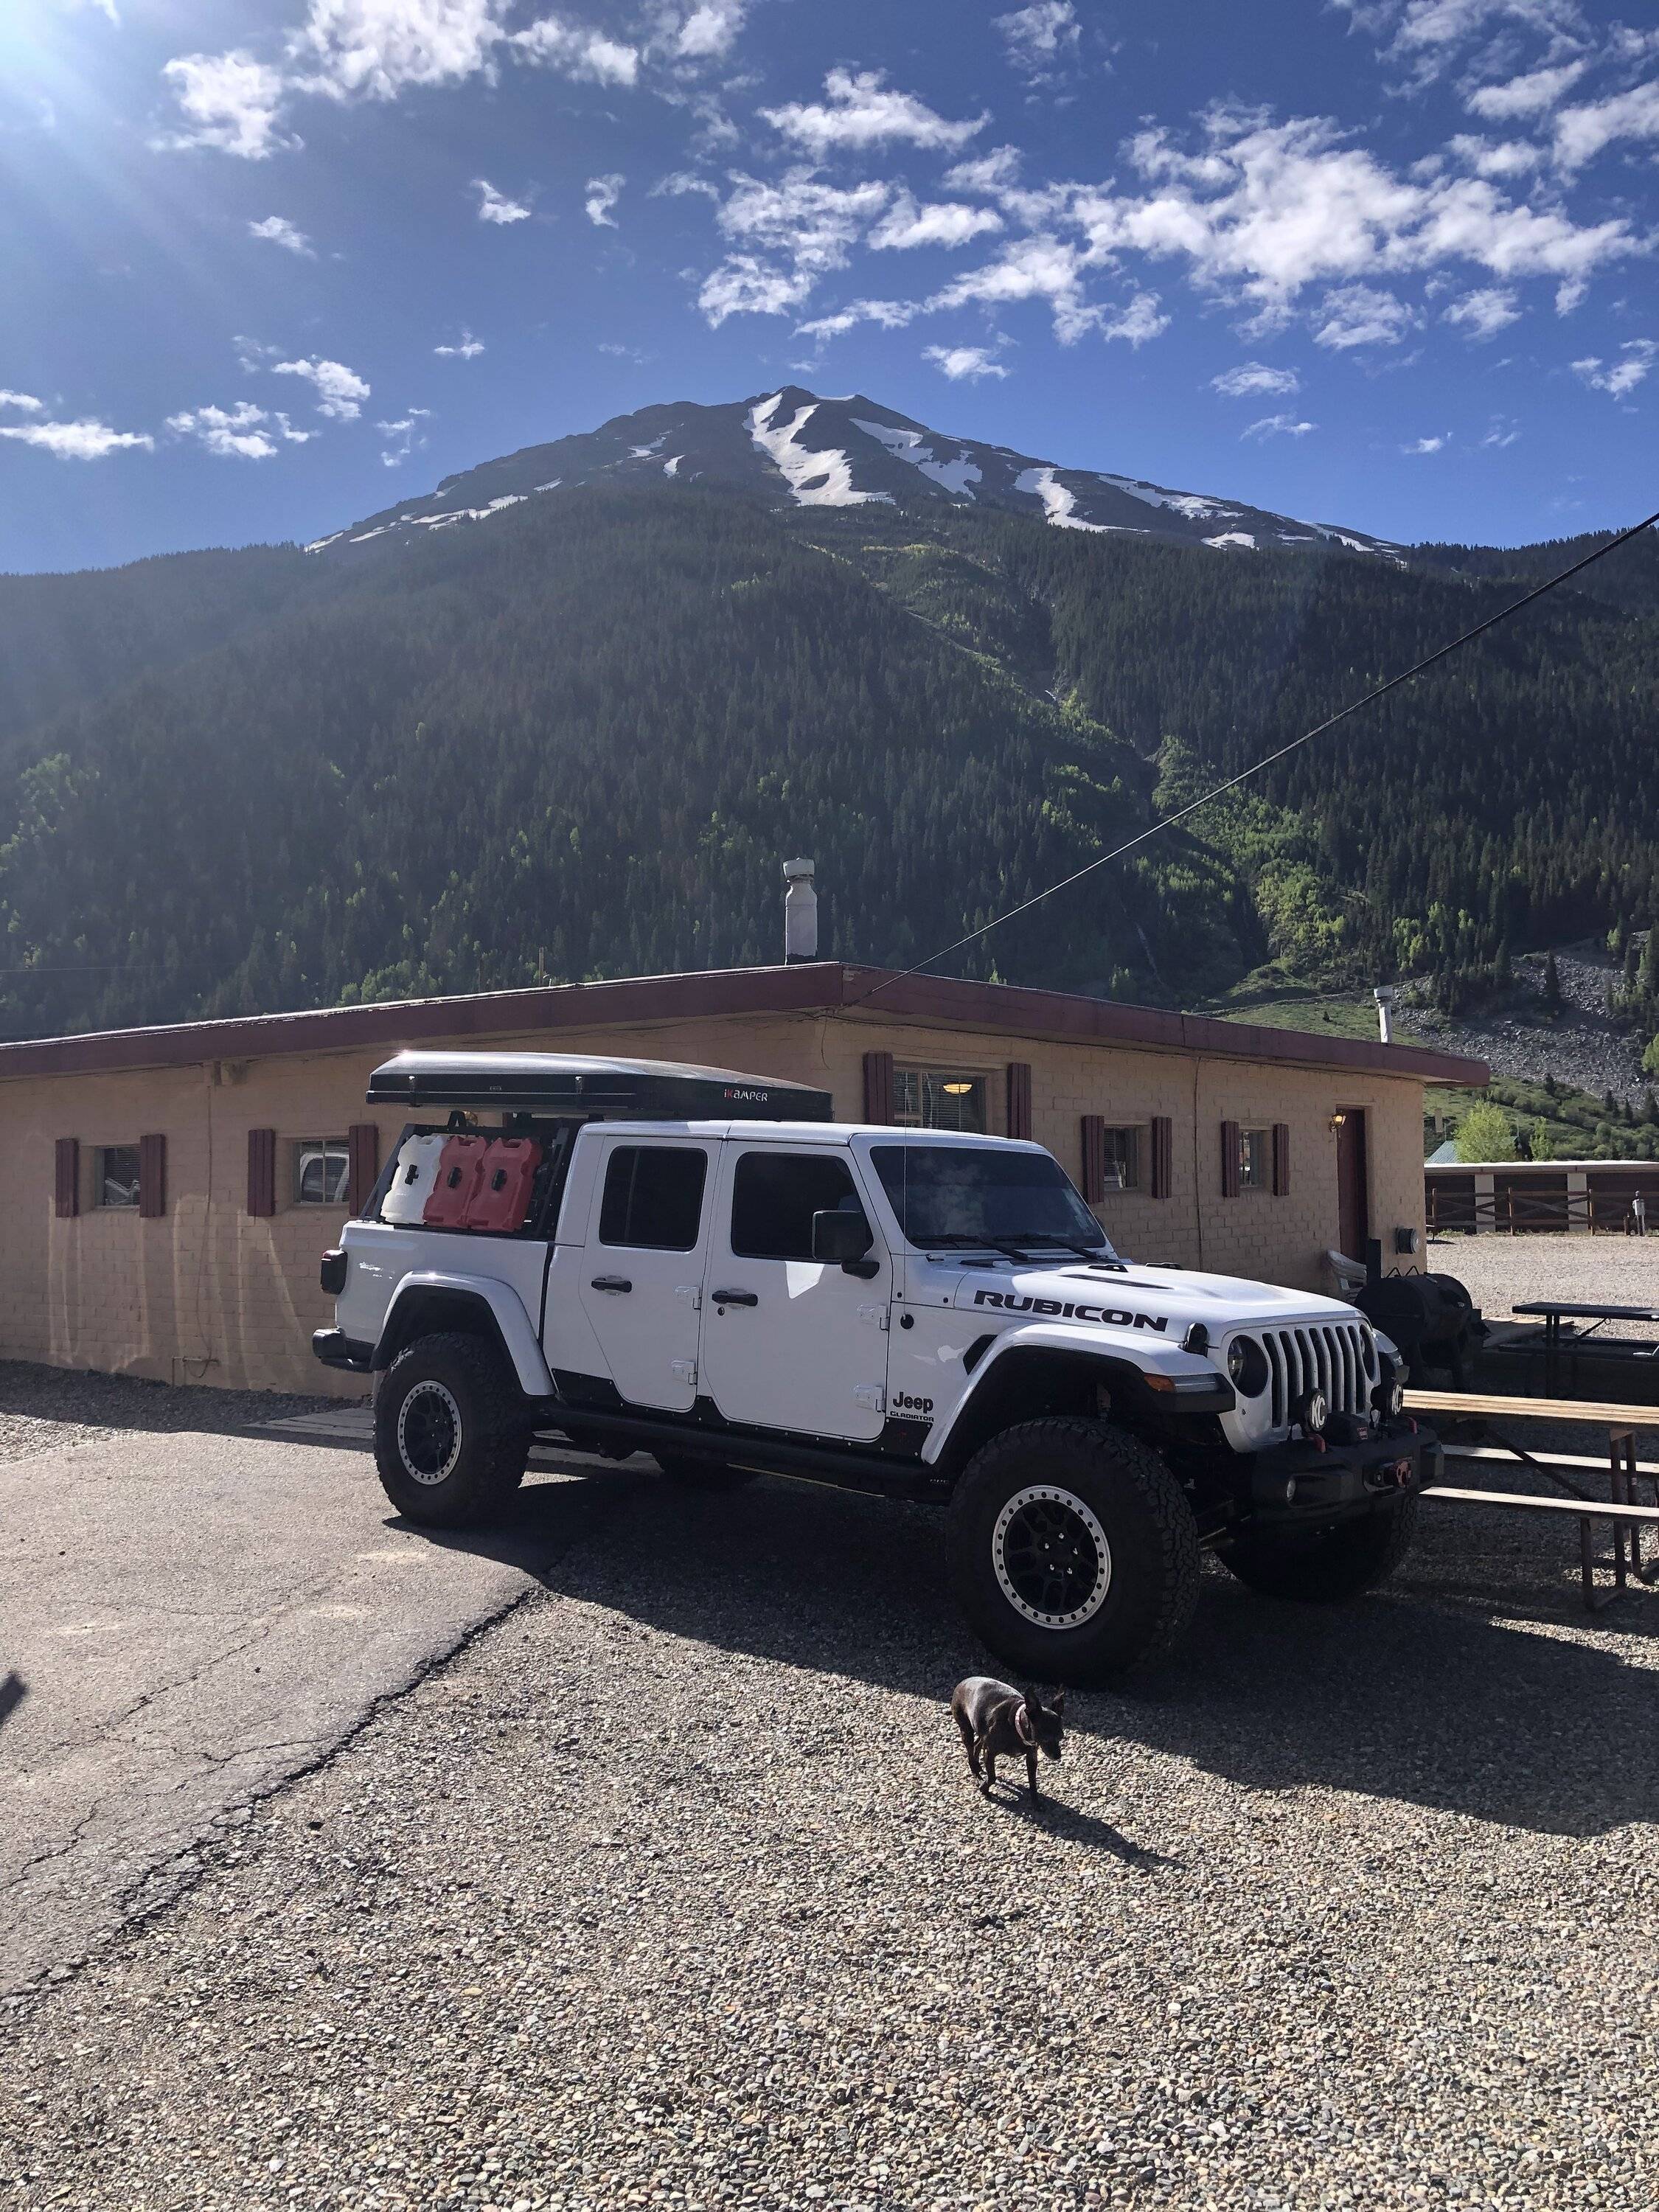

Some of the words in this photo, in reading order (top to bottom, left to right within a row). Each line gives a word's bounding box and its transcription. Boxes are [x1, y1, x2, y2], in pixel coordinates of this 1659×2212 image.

[973, 1290, 1169, 1332] RUBICON
[892, 1391, 933, 1413] Jeep
[1311, 1394, 1326, 1428] KC
[1391, 1384, 1402, 1415] KC
[889, 1411, 934, 1422] GLADIATOR
